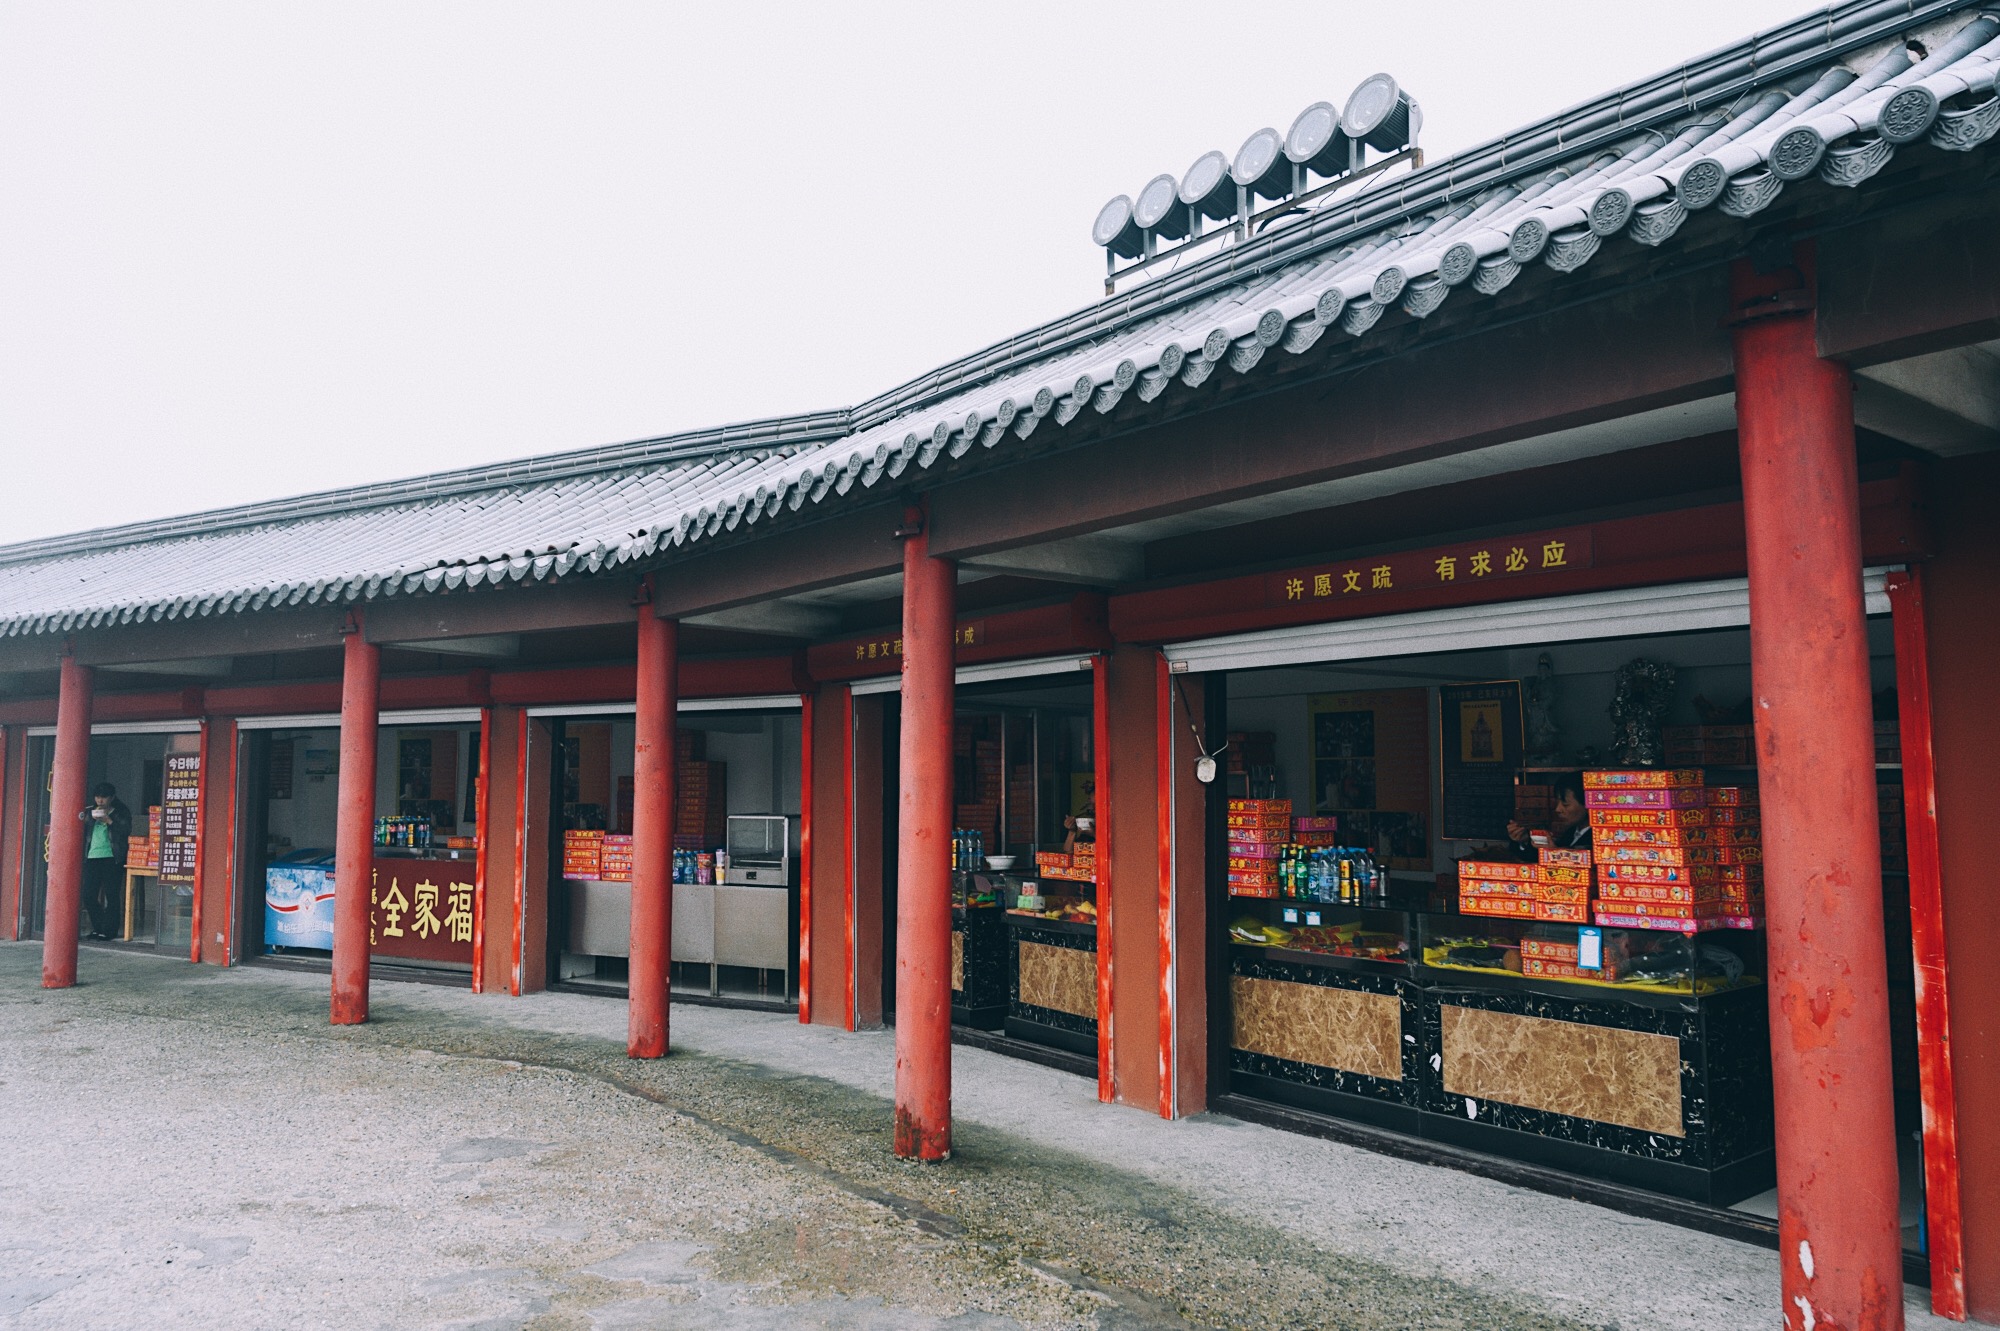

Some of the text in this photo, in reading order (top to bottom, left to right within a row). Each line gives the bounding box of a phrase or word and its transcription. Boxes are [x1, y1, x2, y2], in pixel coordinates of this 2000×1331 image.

[1286, 540, 1568, 601] 许愿文疏 有求必应
[380, 876, 474, 943] 全家福
